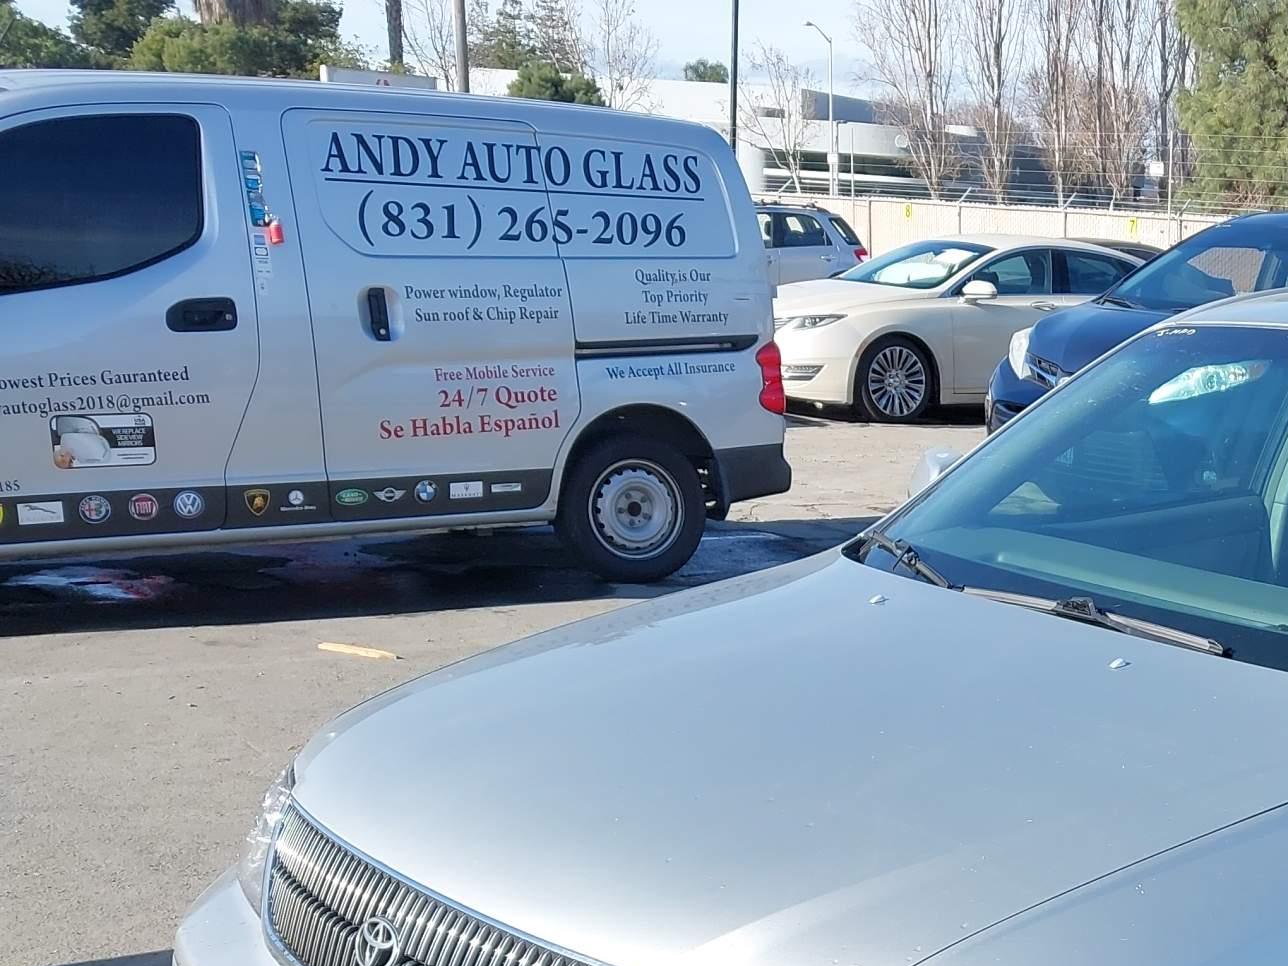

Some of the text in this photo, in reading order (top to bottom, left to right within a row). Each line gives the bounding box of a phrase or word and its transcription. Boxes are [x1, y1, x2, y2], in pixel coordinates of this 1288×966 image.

[320, 131, 702, 194] ANDY AUTO GLASS
[358, 189, 687, 250] (831) 265-2096
[678, 270, 687, 282] is
[689, 268, 712, 282] Our
[404, 284, 563, 302] Power window, Regulator
[641, 290, 709, 307] Top Priority
[415, 306, 560, 324] Sun roof & Chip Repair
[624, 311, 729, 326] Life Time Warranty
[0, 365, 190, 390] owest Prices Gauranteed
[434, 364, 555, 382] Free Mobile Service
[605, 361, 736, 380] We Accept All Insurance
[0, 390, 211, 418] autoglass2018@gmail.com
[437, 384, 558, 409] 24/7 Quote
[379, 409, 561, 440] Se Habla Español
